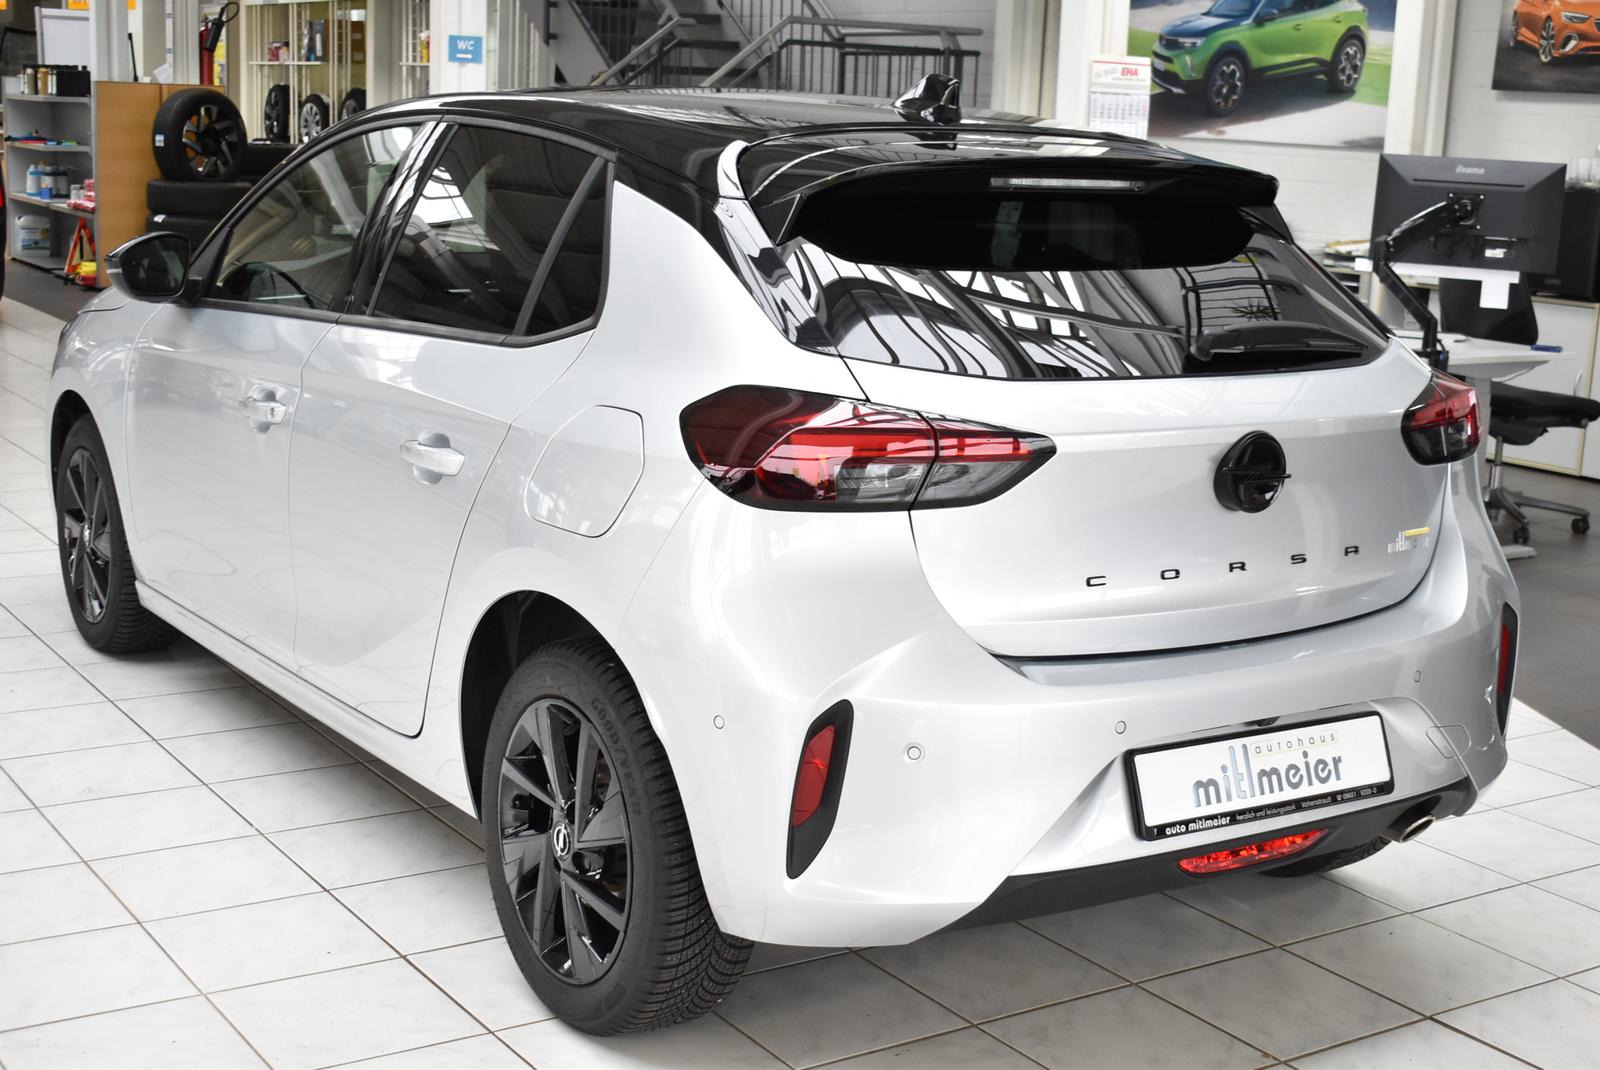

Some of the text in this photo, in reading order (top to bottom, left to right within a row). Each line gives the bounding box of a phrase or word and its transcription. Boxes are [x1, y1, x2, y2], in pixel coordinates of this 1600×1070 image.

[456, 39, 475, 50] WC
[1085, 545, 1360, 588] CORSA
[591, 697, 641, 816] GOODYEAR
[1255, 733, 1336, 754] autohaus
[1192, 743, 1343, 808] mitlmeier
[1165, 824, 1186, 835] auto
[1188, 815, 1231, 831] mitlmeier
